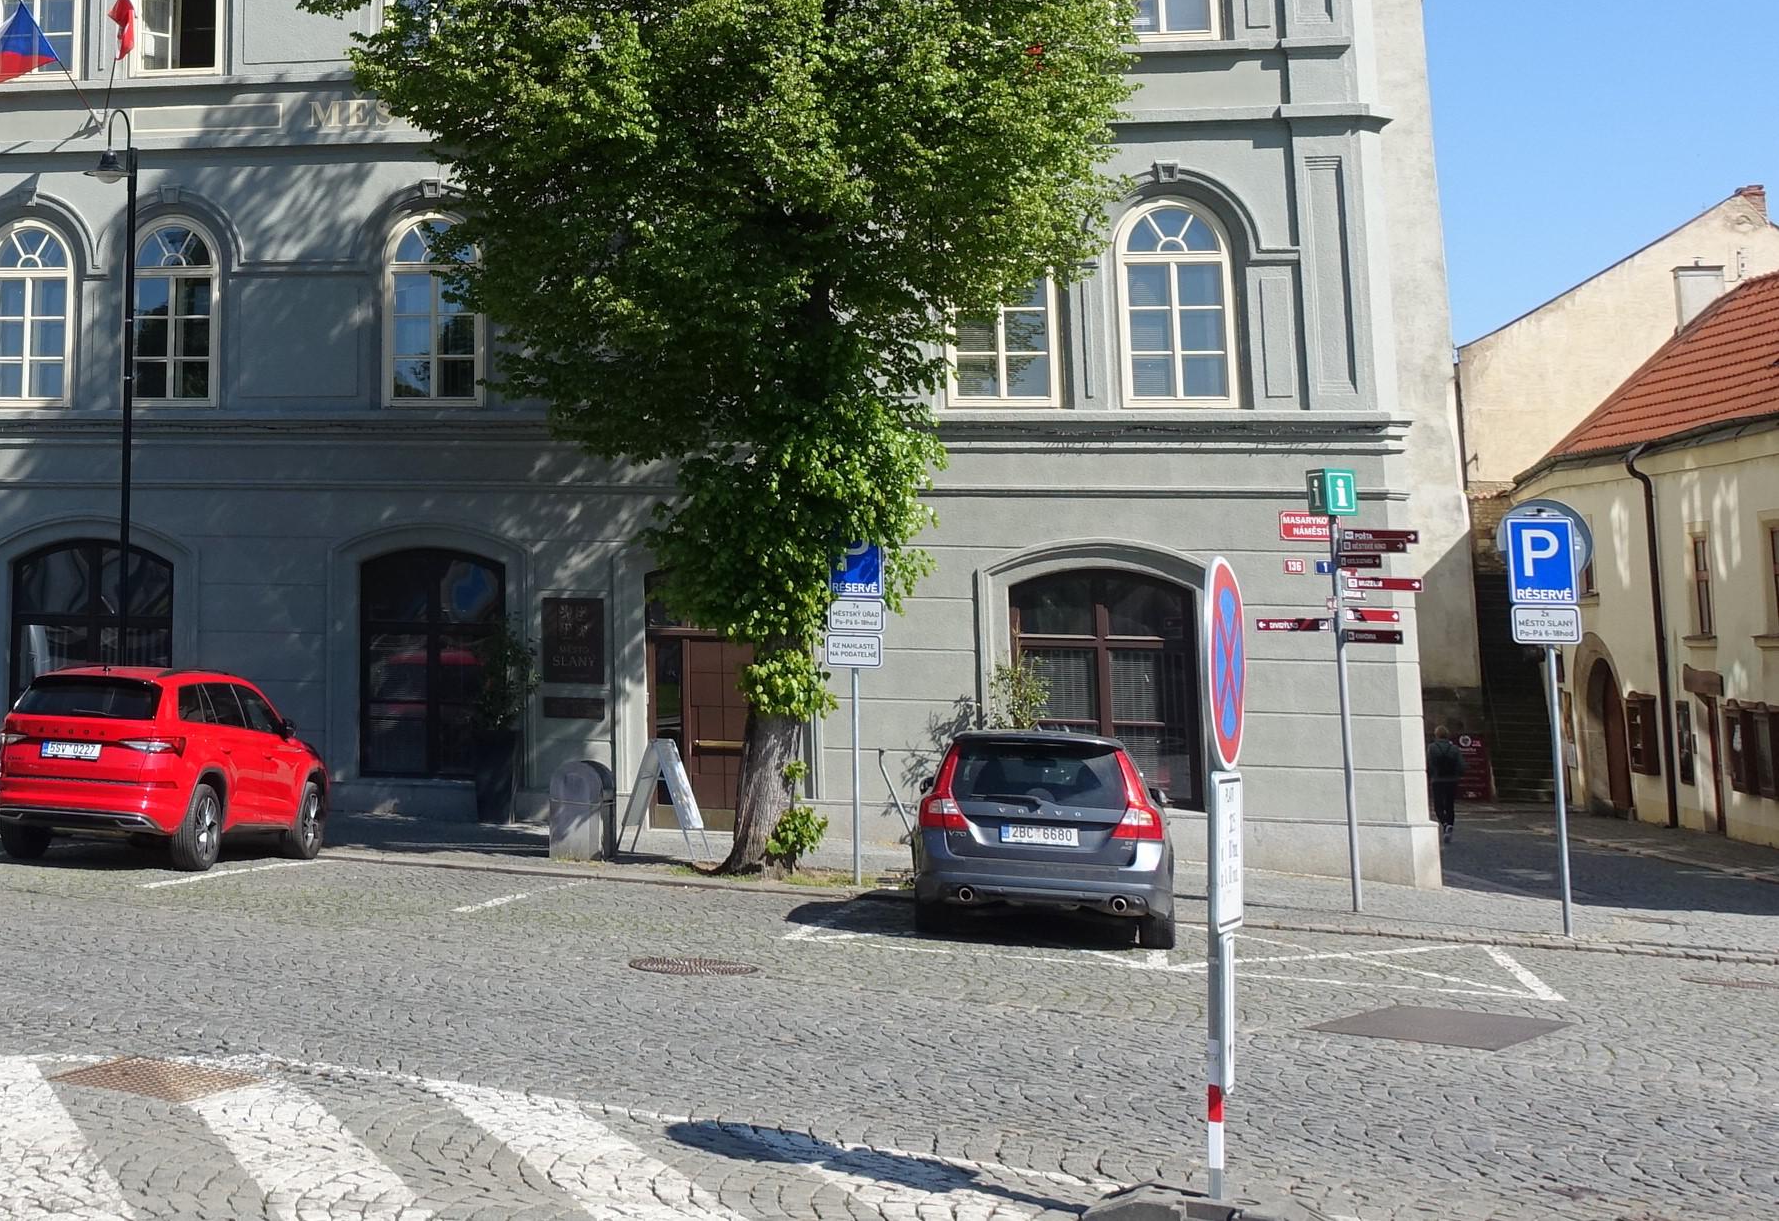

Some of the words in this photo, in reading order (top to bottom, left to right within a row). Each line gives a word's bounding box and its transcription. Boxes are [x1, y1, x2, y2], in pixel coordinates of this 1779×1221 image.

[1282, 516, 1339, 525] MASARYKO
[1287, 561, 1302, 572] 136
[833, 582, 878, 593] RÉSERVÉ
[1517, 586, 1573, 600] RÉSERVÉ
[1518, 619, 1546, 627] MĚSTO
[1547, 619, 1574, 627] SLANÝ
[49, 742, 66, 753] 5SV
[73, 744, 96, 755] 0227
[998, 807, 1082, 817] VOLVO
[1012, 827, 1034, 839] 2BC
[1042, 828, 1072, 841] 6680
